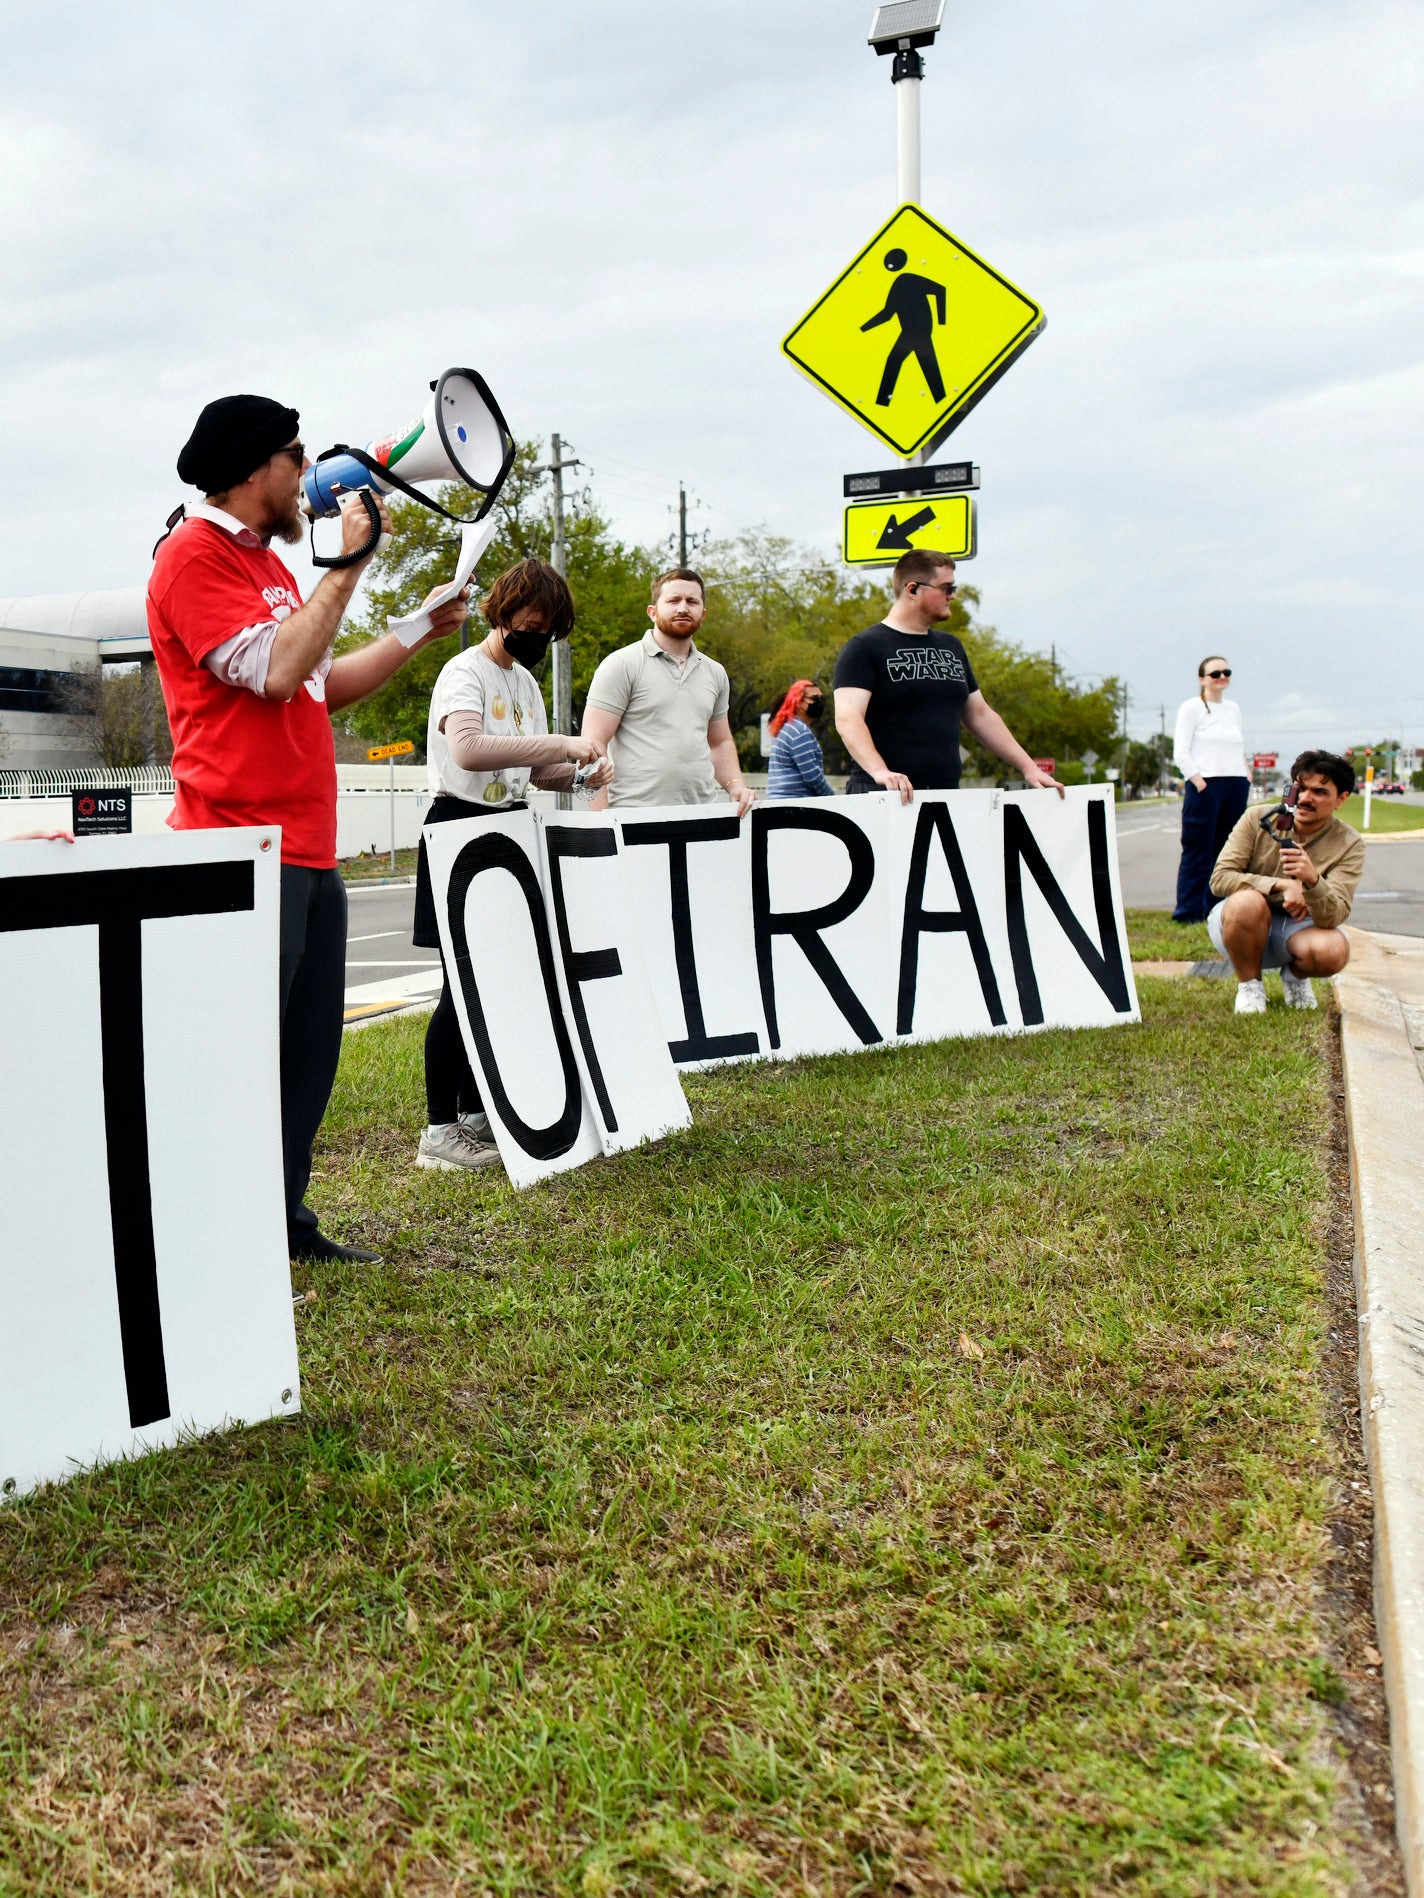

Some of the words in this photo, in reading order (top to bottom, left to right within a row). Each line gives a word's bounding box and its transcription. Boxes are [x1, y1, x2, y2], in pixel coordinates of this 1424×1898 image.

[887, 648, 963, 666] STAR
[887, 664, 966, 682] WARS
[98, 799, 126, 811] NTS
[446, 825, 623, 1161] OF
[622, 800, 1132, 1063] IRAN
